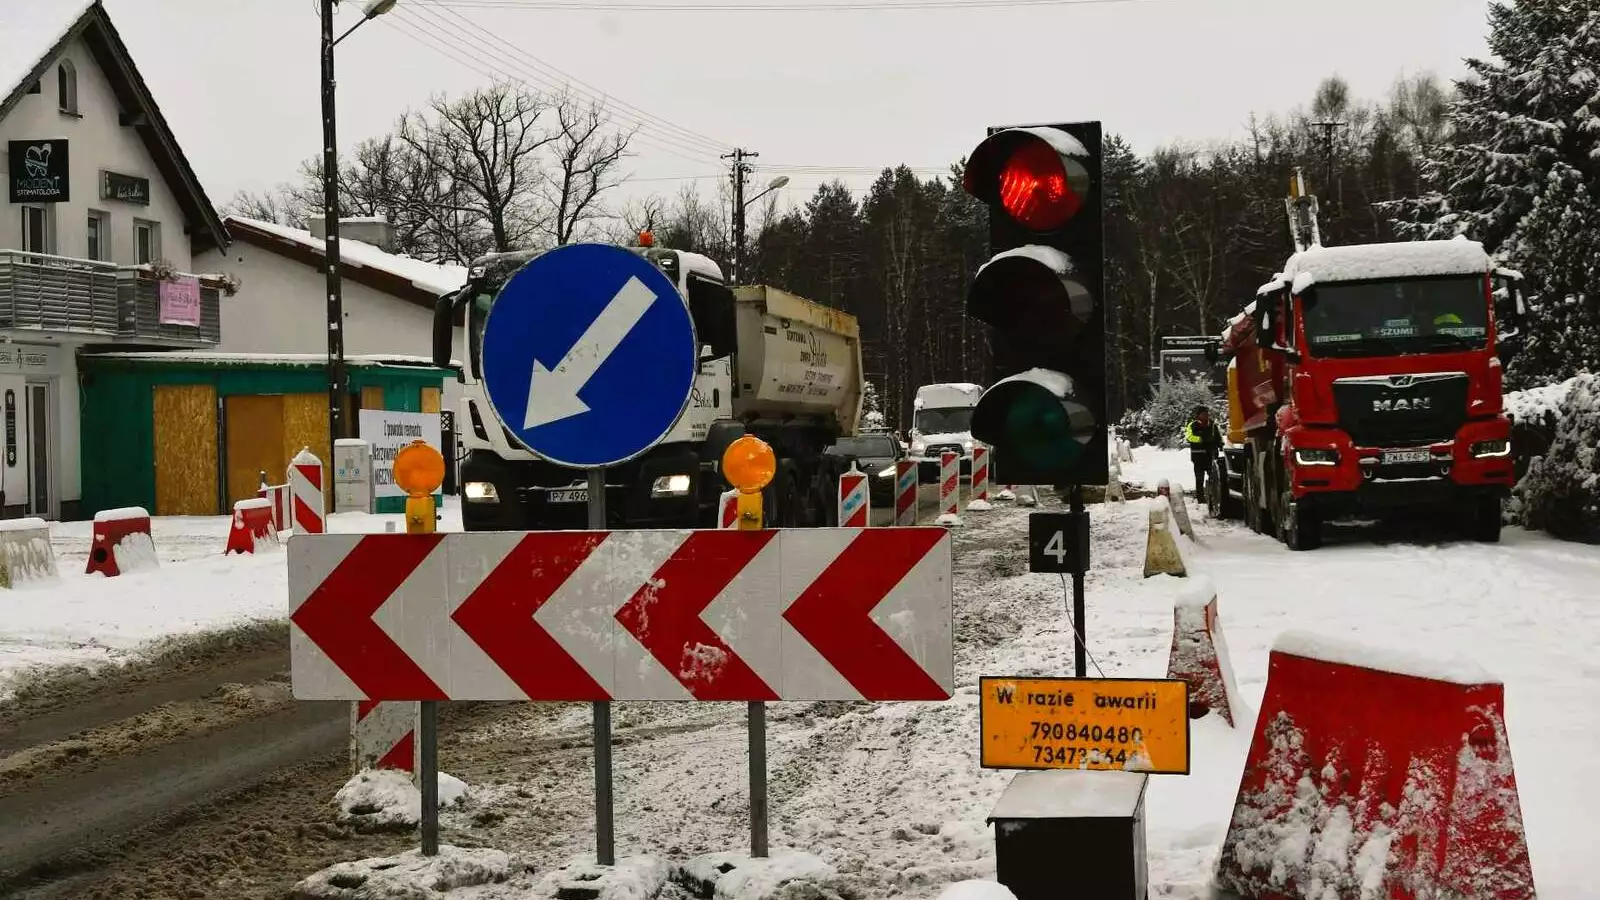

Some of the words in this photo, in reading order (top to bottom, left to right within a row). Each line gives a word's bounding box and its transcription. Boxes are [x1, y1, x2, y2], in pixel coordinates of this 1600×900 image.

[17, 188, 61, 196] STOMATOLOGIA
[1379, 328, 1414, 336] SZUMI
[1372, 397, 1431, 412] MAN
[569, 491, 590, 501] 496
[1043, 530, 1067, 564] 4
[996, 687, 1013, 705] W
[1027, 690, 1075, 707] razie
[1094, 692, 1156, 710] awarii
[1030, 721, 1142, 744] 790840480
